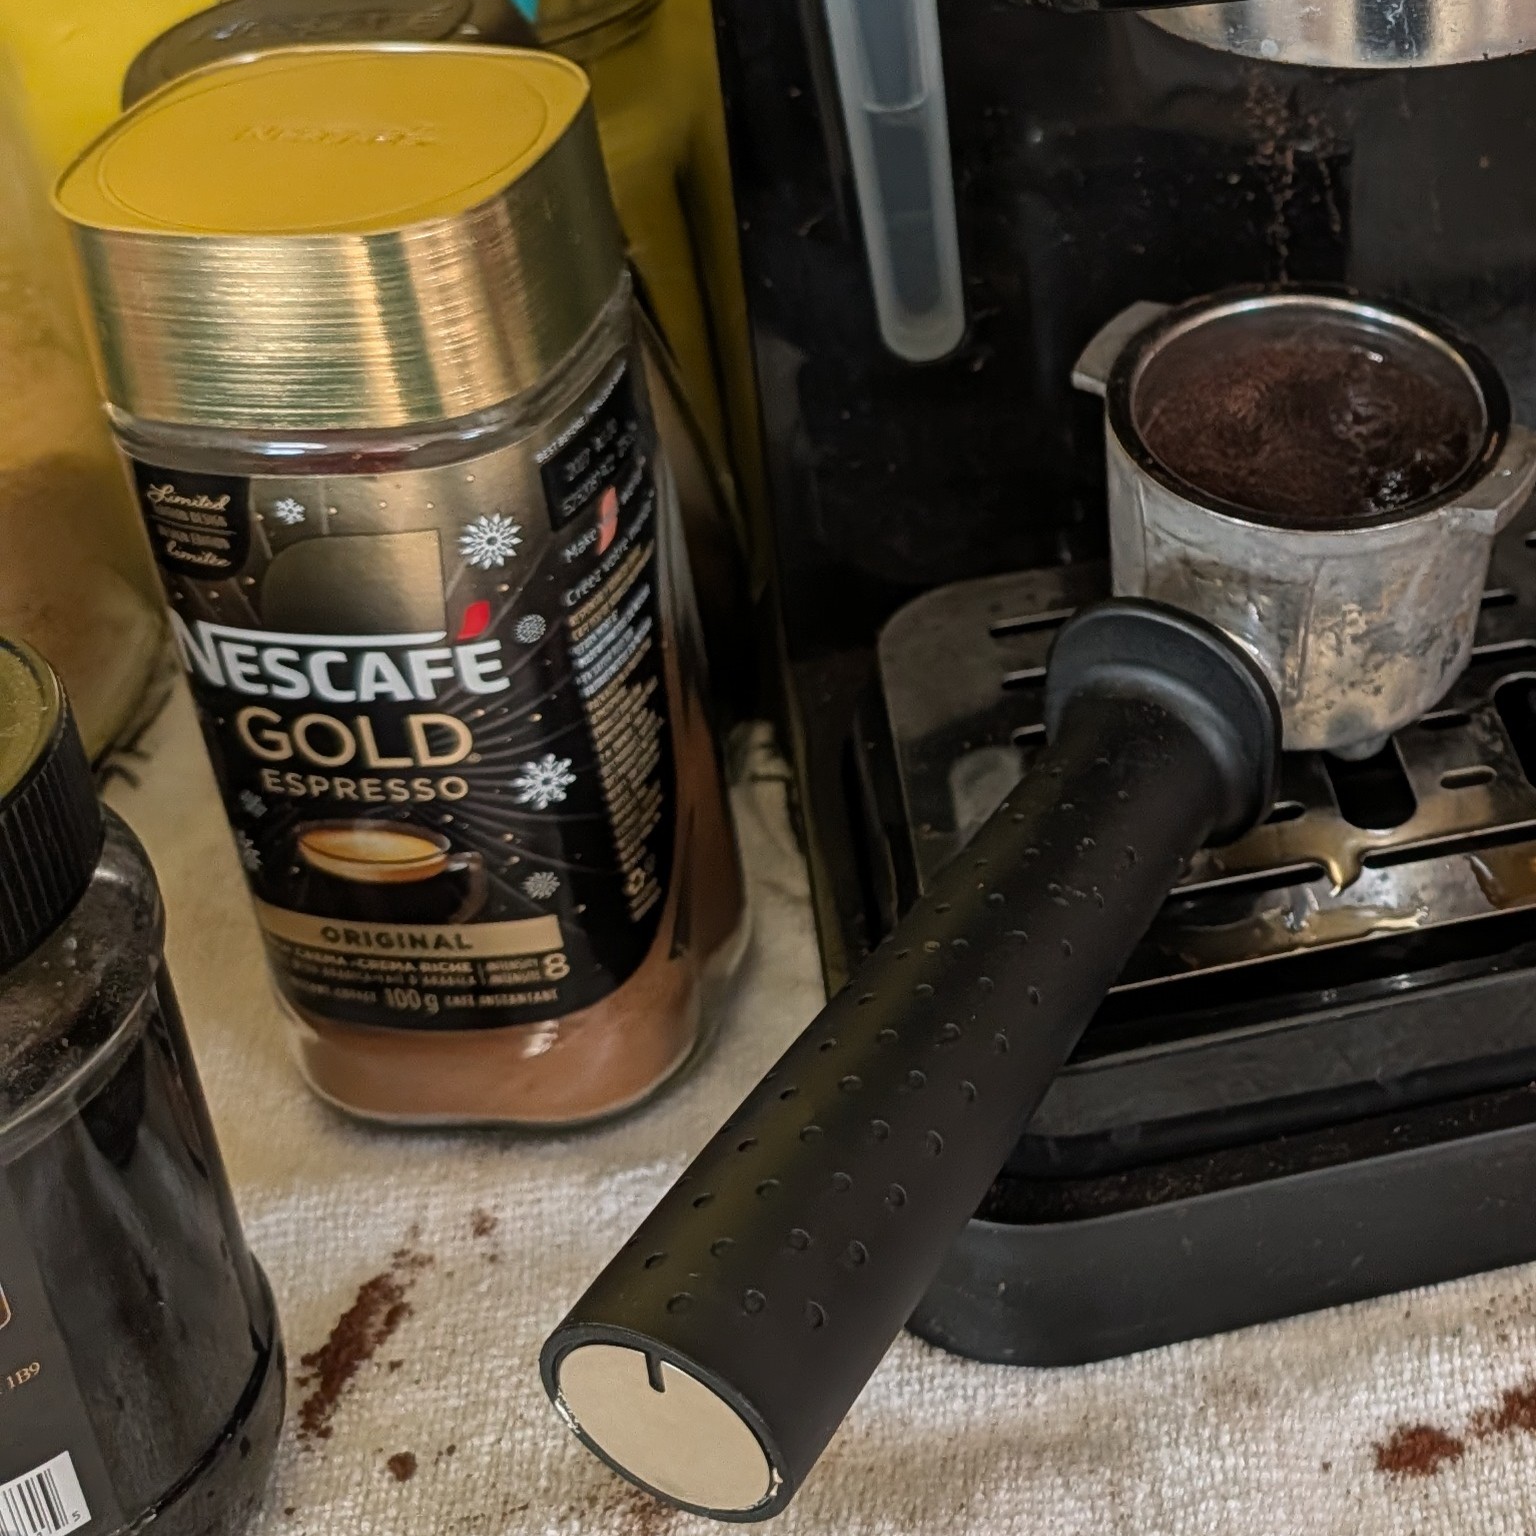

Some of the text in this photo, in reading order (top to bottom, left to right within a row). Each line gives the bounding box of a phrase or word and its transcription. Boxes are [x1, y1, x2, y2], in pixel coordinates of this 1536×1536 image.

[234, 705, 474, 768] GOLD
[258, 768, 470, 803] ESPRESSO
[320, 925, 474, 950] ORIGINAL
